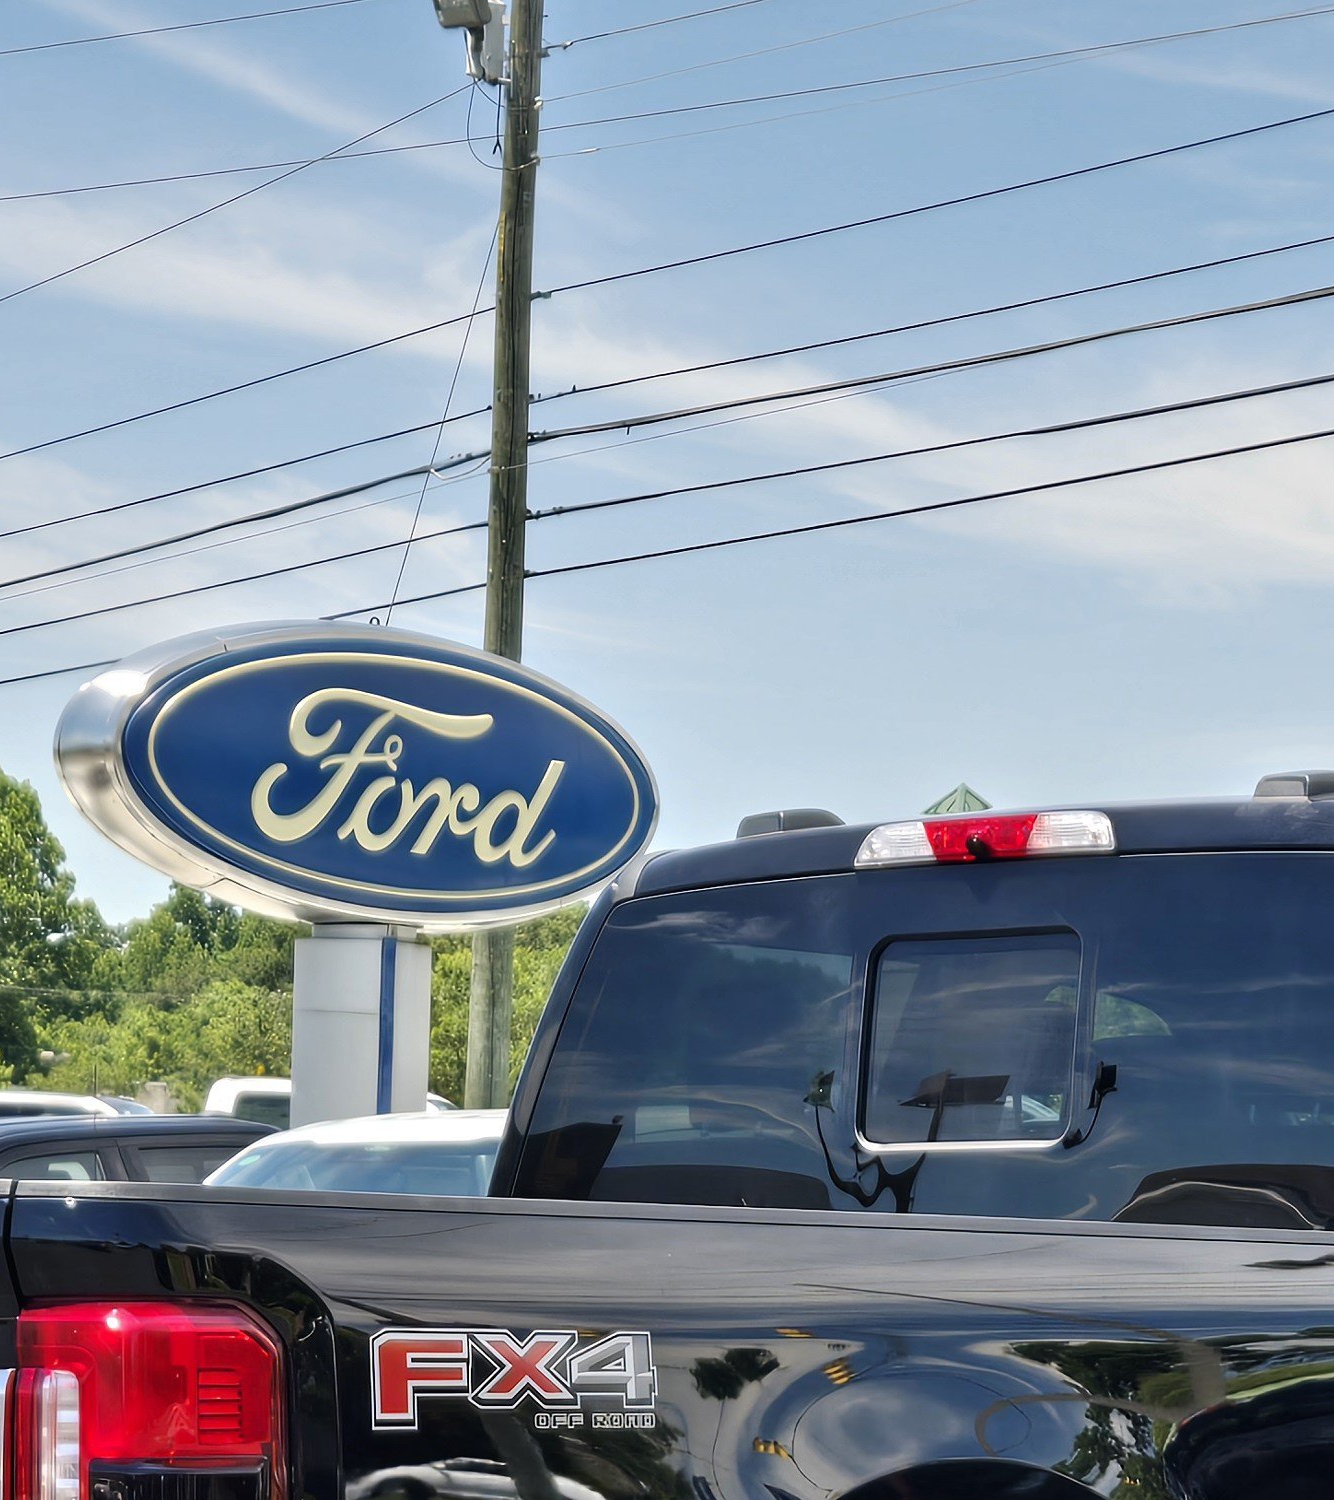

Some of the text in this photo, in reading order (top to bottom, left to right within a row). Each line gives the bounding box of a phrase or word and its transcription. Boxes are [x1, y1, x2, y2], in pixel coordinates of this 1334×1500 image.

[251, 688, 565, 868] Ford
[368, 1328, 659, 1431] FX4
[534, 1412, 656, 1429] OFF ROAD
